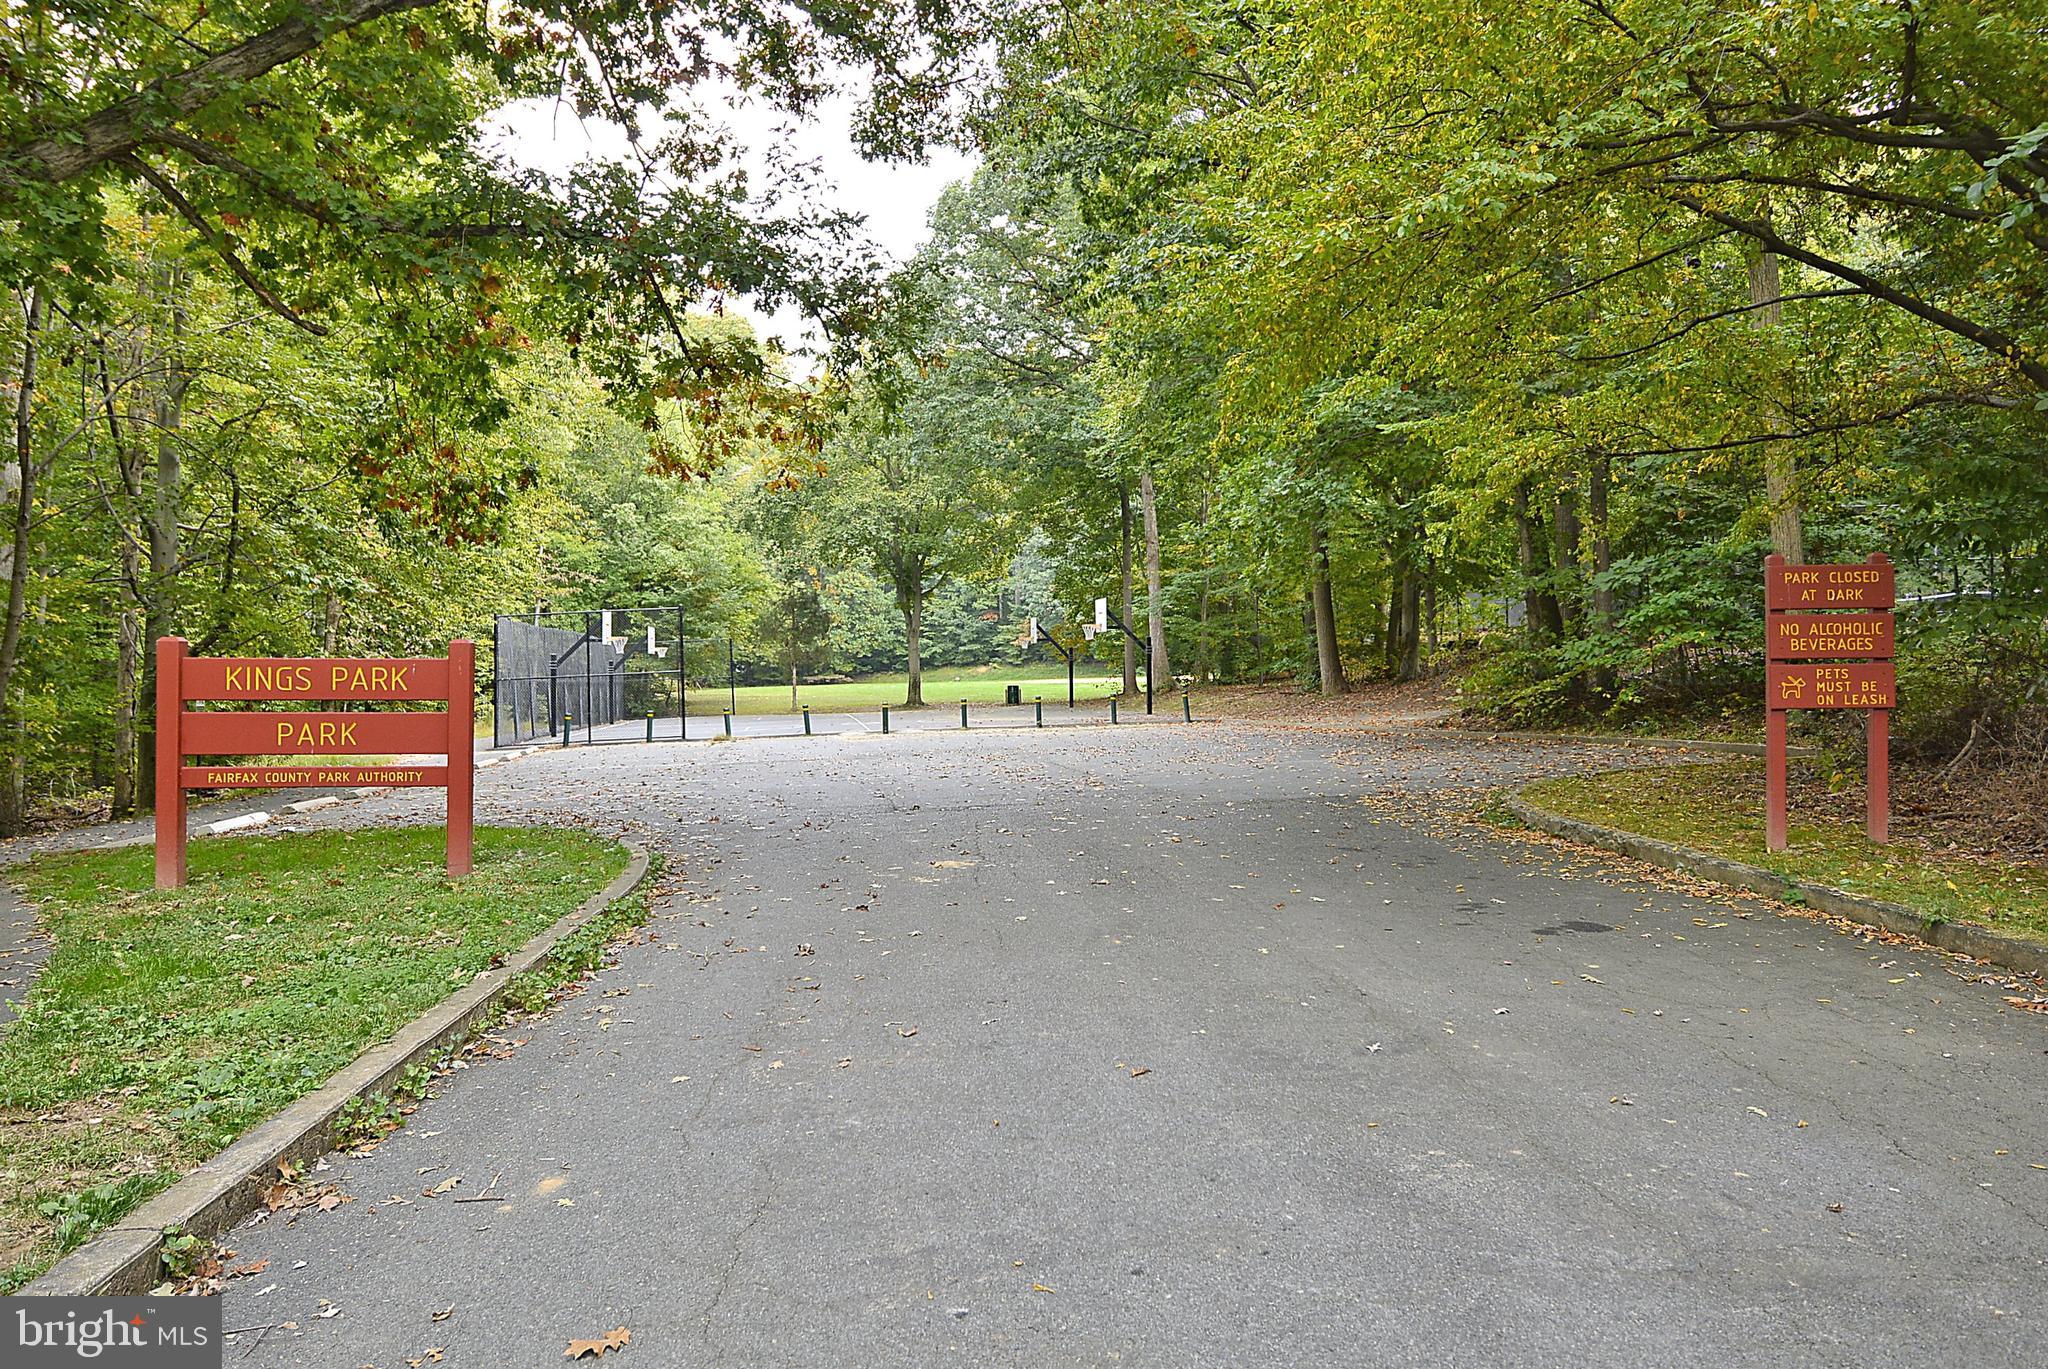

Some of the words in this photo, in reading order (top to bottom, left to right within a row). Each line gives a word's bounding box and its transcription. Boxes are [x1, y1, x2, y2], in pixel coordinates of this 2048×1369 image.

[1785, 572, 1819, 584] PARK
[1829, 571, 1879, 583] CLOSED
[1801, 590, 1817, 600] AT
[1827, 589, 1863, 601] DARK
[1780, 623, 1799, 636] NO
[1809, 623, 1883, 635] ALCOHOLIC
[1791, 638, 1873, 651] BEVERAGES
[225, 666, 312, 691] KINGS
[332, 667, 408, 691] PARK
[1816, 669, 1849, 679] PETS
[1817, 682, 1851, 692] MUST
[1862, 681, 1877, 691] BE
[1817, 695, 1834, 705] ON
[1844, 694, 1887, 704] LEASH
[277, 722, 357, 746] PARK
[208, 772, 258, 783] FAIRFAX
[265, 772, 311, 783] COUNTY
[319, 772, 350, 782] PARK
[357, 771, 422, 782] AUTHORITY
